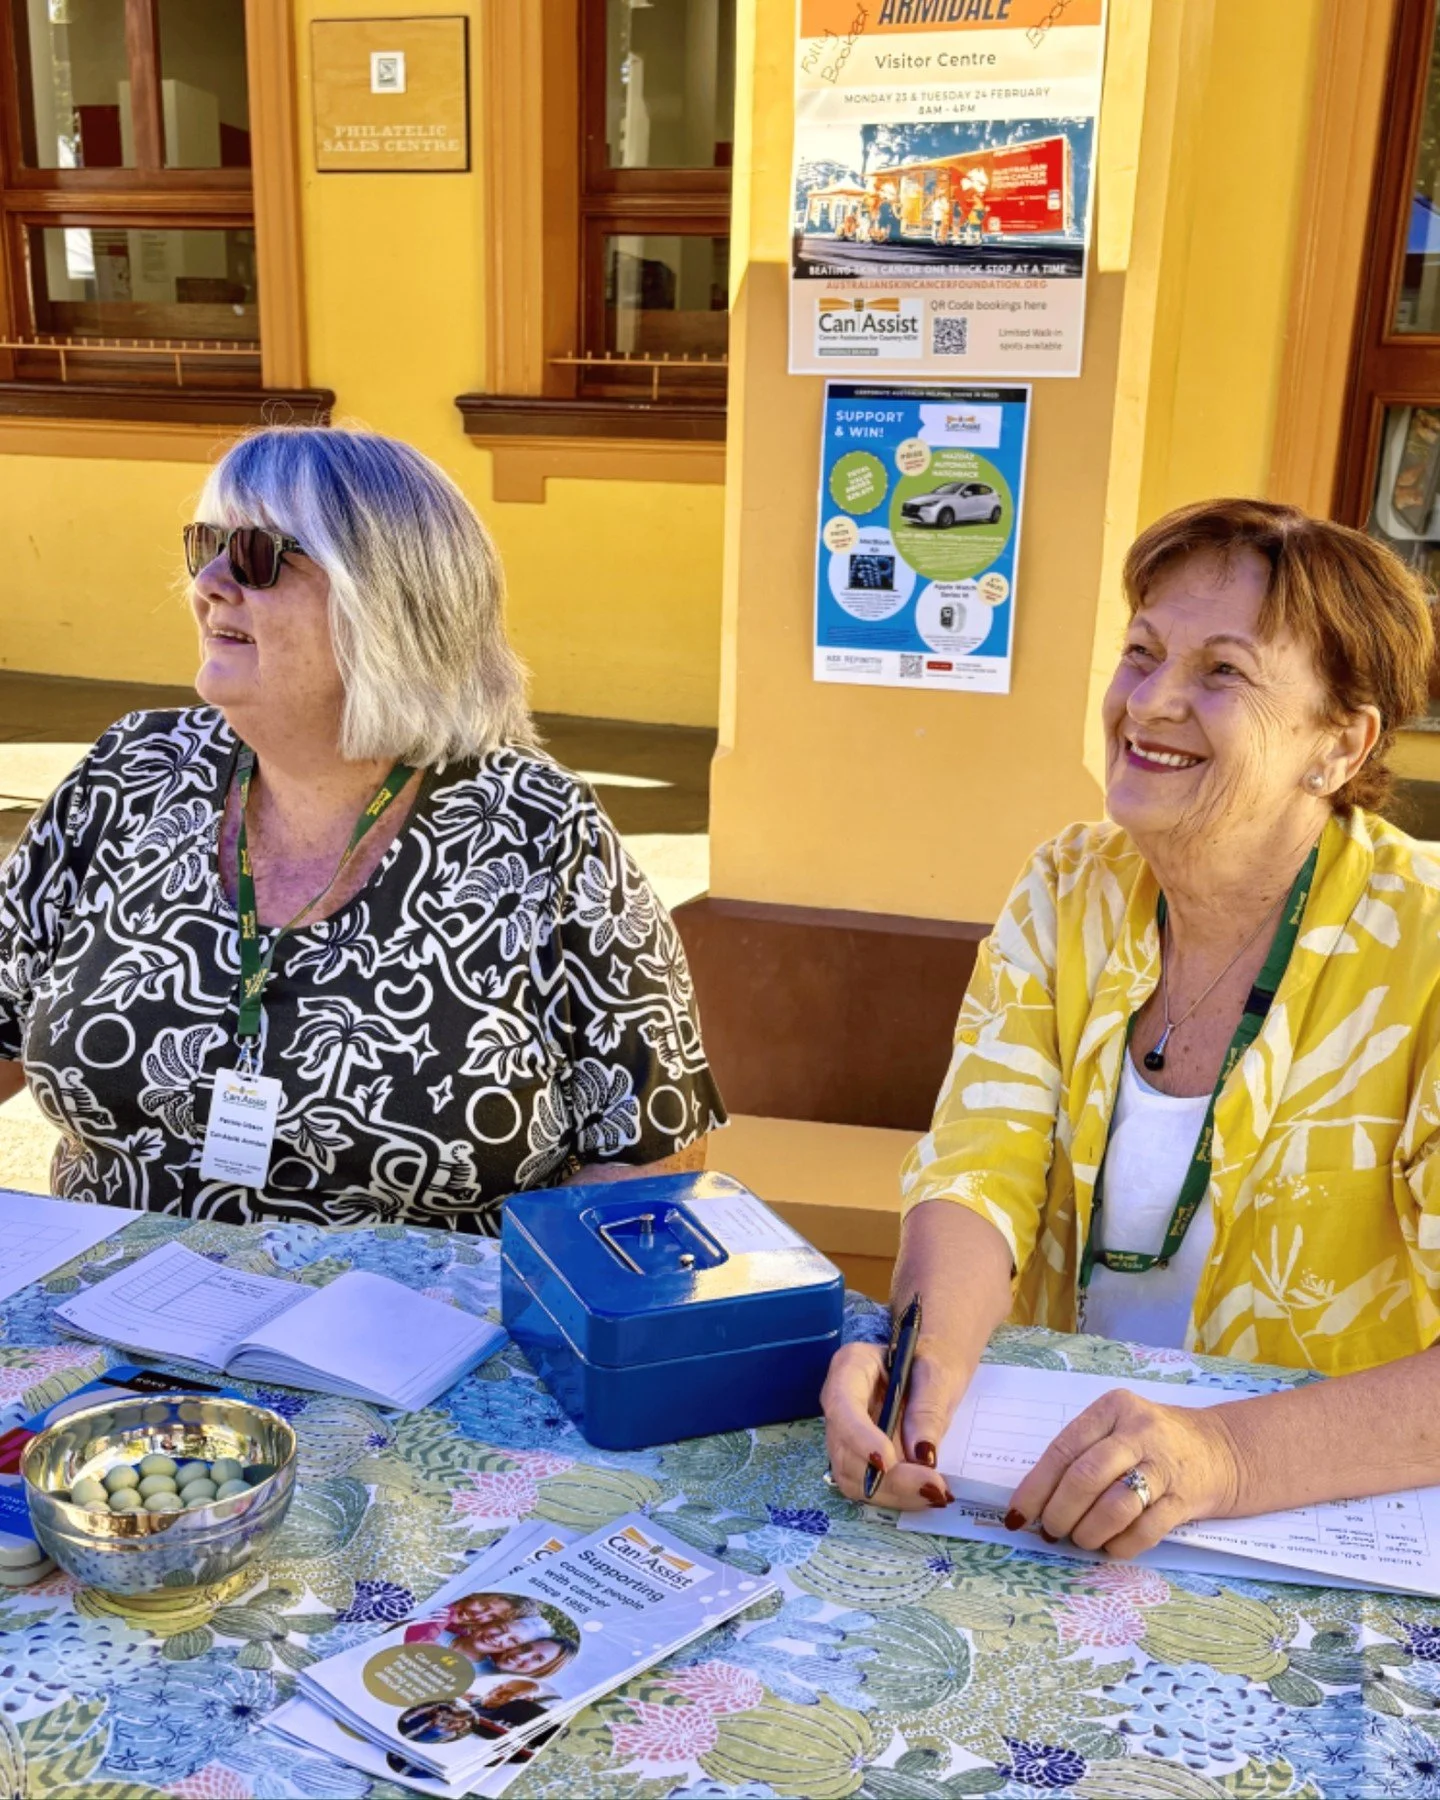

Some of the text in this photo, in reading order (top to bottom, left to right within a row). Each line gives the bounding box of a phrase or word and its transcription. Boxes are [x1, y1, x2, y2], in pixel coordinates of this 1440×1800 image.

[877, 0, 1011, 26] ARMIDALE
[875, 52, 996, 69] Visitor Centre
[844, 93, 892, 104] MONDAY
[896, 92, 907, 102] 23
[921, 90, 970, 101] TUESDAY
[974, 89, 987, 99] 24
[991, 87, 1051, 98] FEBRUARY
[917, 105, 942, 115] 8AM
[952, 104, 976, 113] 4PM
[334, 125, 447, 137] PHILATELIC
[323, 139, 460, 152] SALES CENTRE
[809, 265, 853, 275] BEATING
[881, 264, 923, 275] CANCER
[926, 264, 947, 274] ONE
[949, 264, 982, 274] TRUCK
[985, 264, 1012, 274] STOP
[1015, 264, 1028, 274] AT
[1031, 264, 1039, 274] A
[1042, 264, 1067, 274] TIME
[826, 279, 1048, 290] AUSTRALIANSKINCANCERFOUNDATION.ORG
[930, 300, 1048, 312] QR Code bookings here
[819, 313, 918, 333] Can Assist
[999, 328, 1030, 338] Limited
[1024, 341, 1062, 350] available
[836, 410, 905, 423] SUPPORT
[834, 426, 884, 438] & WIN!
[608, 1535, 693, 1588] Can Assist
[578, 1549, 665, 1603] Supporting
[528, 1577, 561, 1597] since
[544, 1569, 570, 1586] with
[569, 1584, 611, 1608] cancer
[560, 1561, 644, 1611] country people
